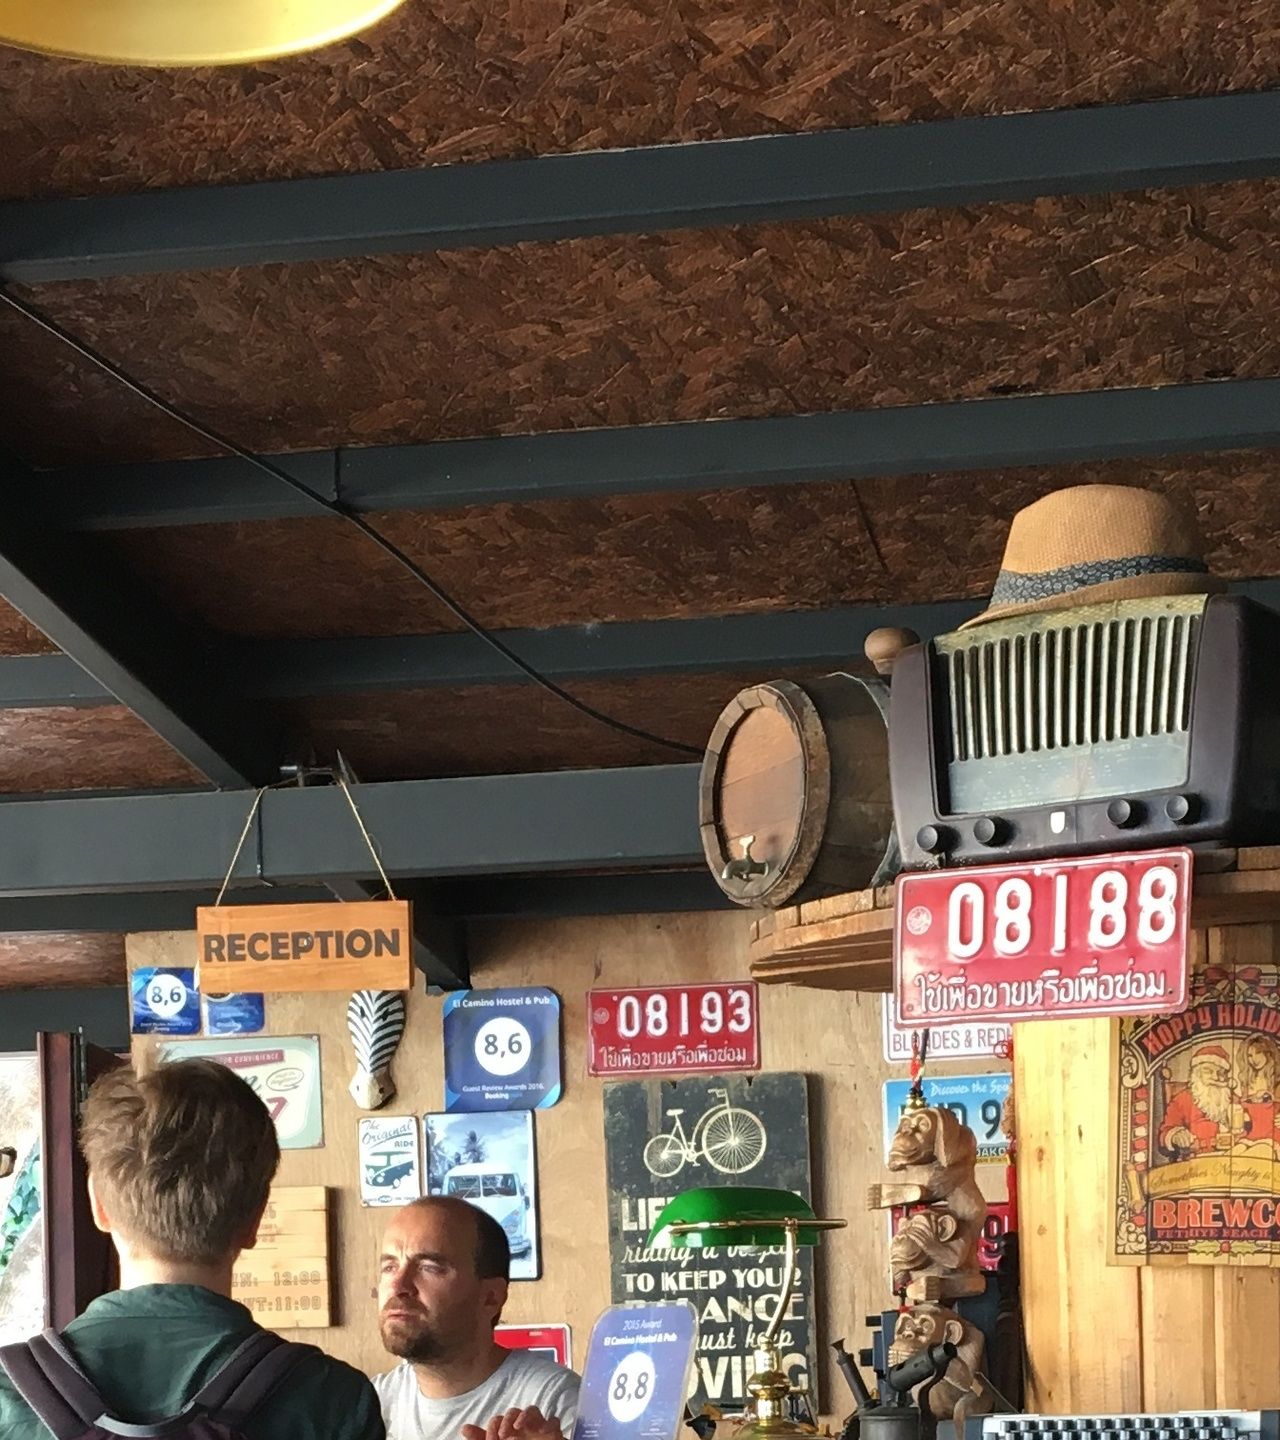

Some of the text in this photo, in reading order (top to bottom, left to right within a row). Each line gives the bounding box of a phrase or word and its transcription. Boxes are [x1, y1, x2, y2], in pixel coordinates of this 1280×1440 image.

[946, 865, 1179, 959] 08188
[203, 928, 401, 962] RECEPTION
[151, 985, 183, 1006] 8,6
[462, 999, 495, 1008] Camino
[617, 990, 751, 1038] 08193
[484, 1032, 523, 1058] 8,6
[1141, 1006, 1215, 1056] HOPPY
[622, 1273, 655, 1293] TO
[661, 1269, 727, 1292] KEEP
[613, 1371, 650, 1402] 8,8
